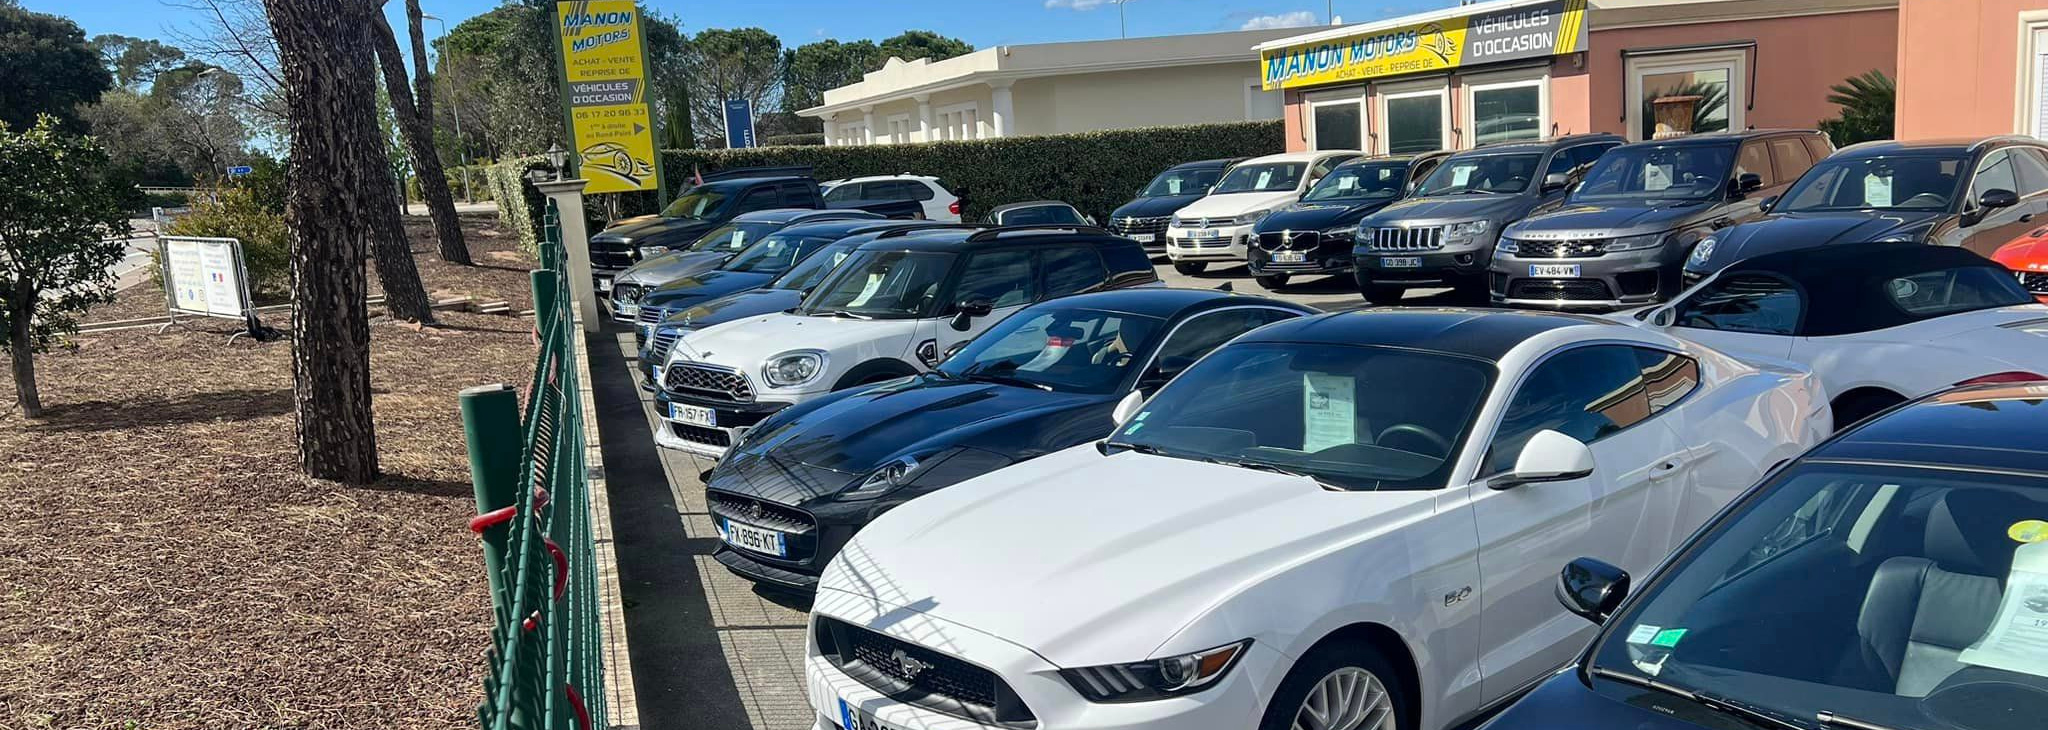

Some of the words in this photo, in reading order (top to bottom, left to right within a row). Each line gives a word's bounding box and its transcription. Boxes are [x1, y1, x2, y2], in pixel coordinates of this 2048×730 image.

[564, 12, 632, 28] MANON
[1475, 9, 1549, 35] VÉHICULES
[572, 29, 630, 52] MOTORS
[1473, 31, 1553, 57] D'OCCASION
[573, 58, 601, 66] ACHAT
[608, 56, 636, 64] VENTE
[1266, 43, 1346, 84] MANON
[1350, 30, 1418, 66] MOTORS
[580, 68, 617, 77] REPRISE
[619, 67, 631, 75] DE
[1336, 68, 1356, 79] ACHAT
[1362, 65, 1384, 75] VENTE
[1390, 60, 1421, 72] REPRISE
[1423, 58, 1433, 69] DE
[573, 82, 629, 93] VÉHICULES
[573, 93, 632, 104] D'OCCASION
[576, 111, 588, 119] 06
[729, 524, 776, 551] FX-896-KT
[1445, 586, 1472, 607] 5.0
